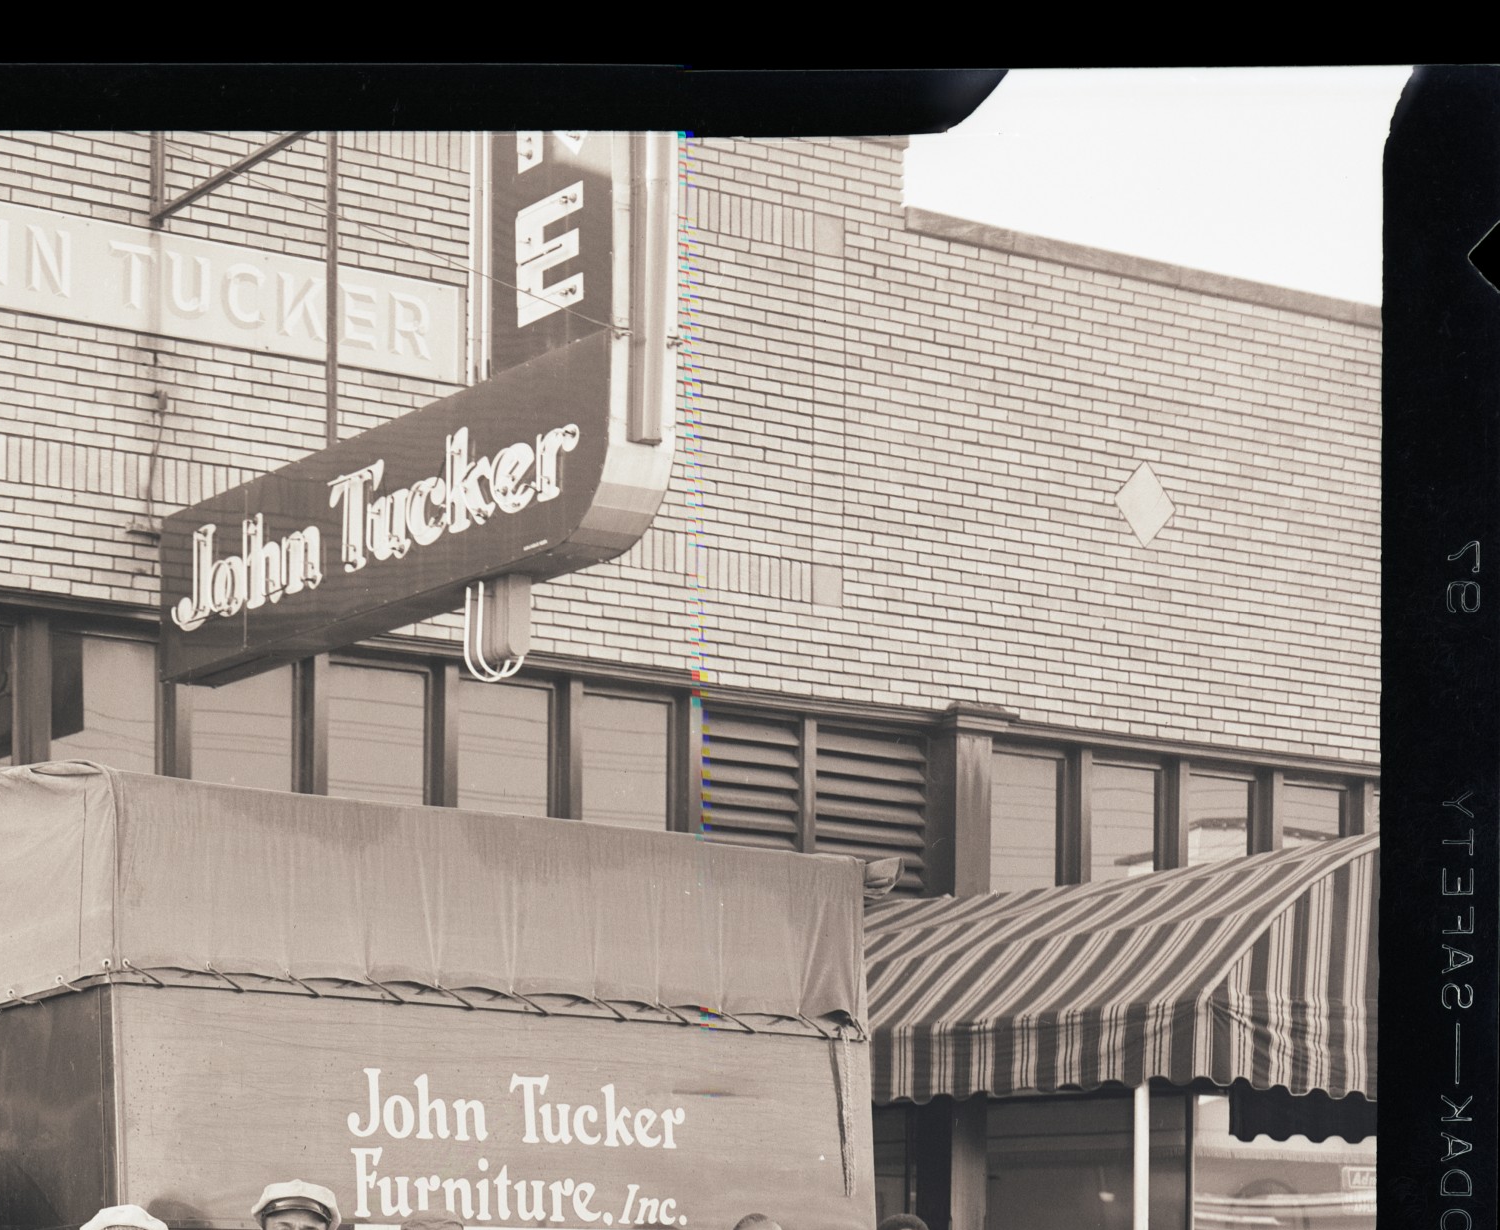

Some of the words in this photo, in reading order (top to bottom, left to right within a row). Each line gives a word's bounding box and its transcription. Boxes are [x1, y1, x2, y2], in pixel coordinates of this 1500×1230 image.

[109, 240, 432, 361] TUCKER
[171, 513, 324, 631] John
[328, 423, 580, 573] Tucker
[347, 1067, 489, 1142] John
[508, 1073, 686, 1150] Tucker
[617, 1183, 689, 1226] Inc.
